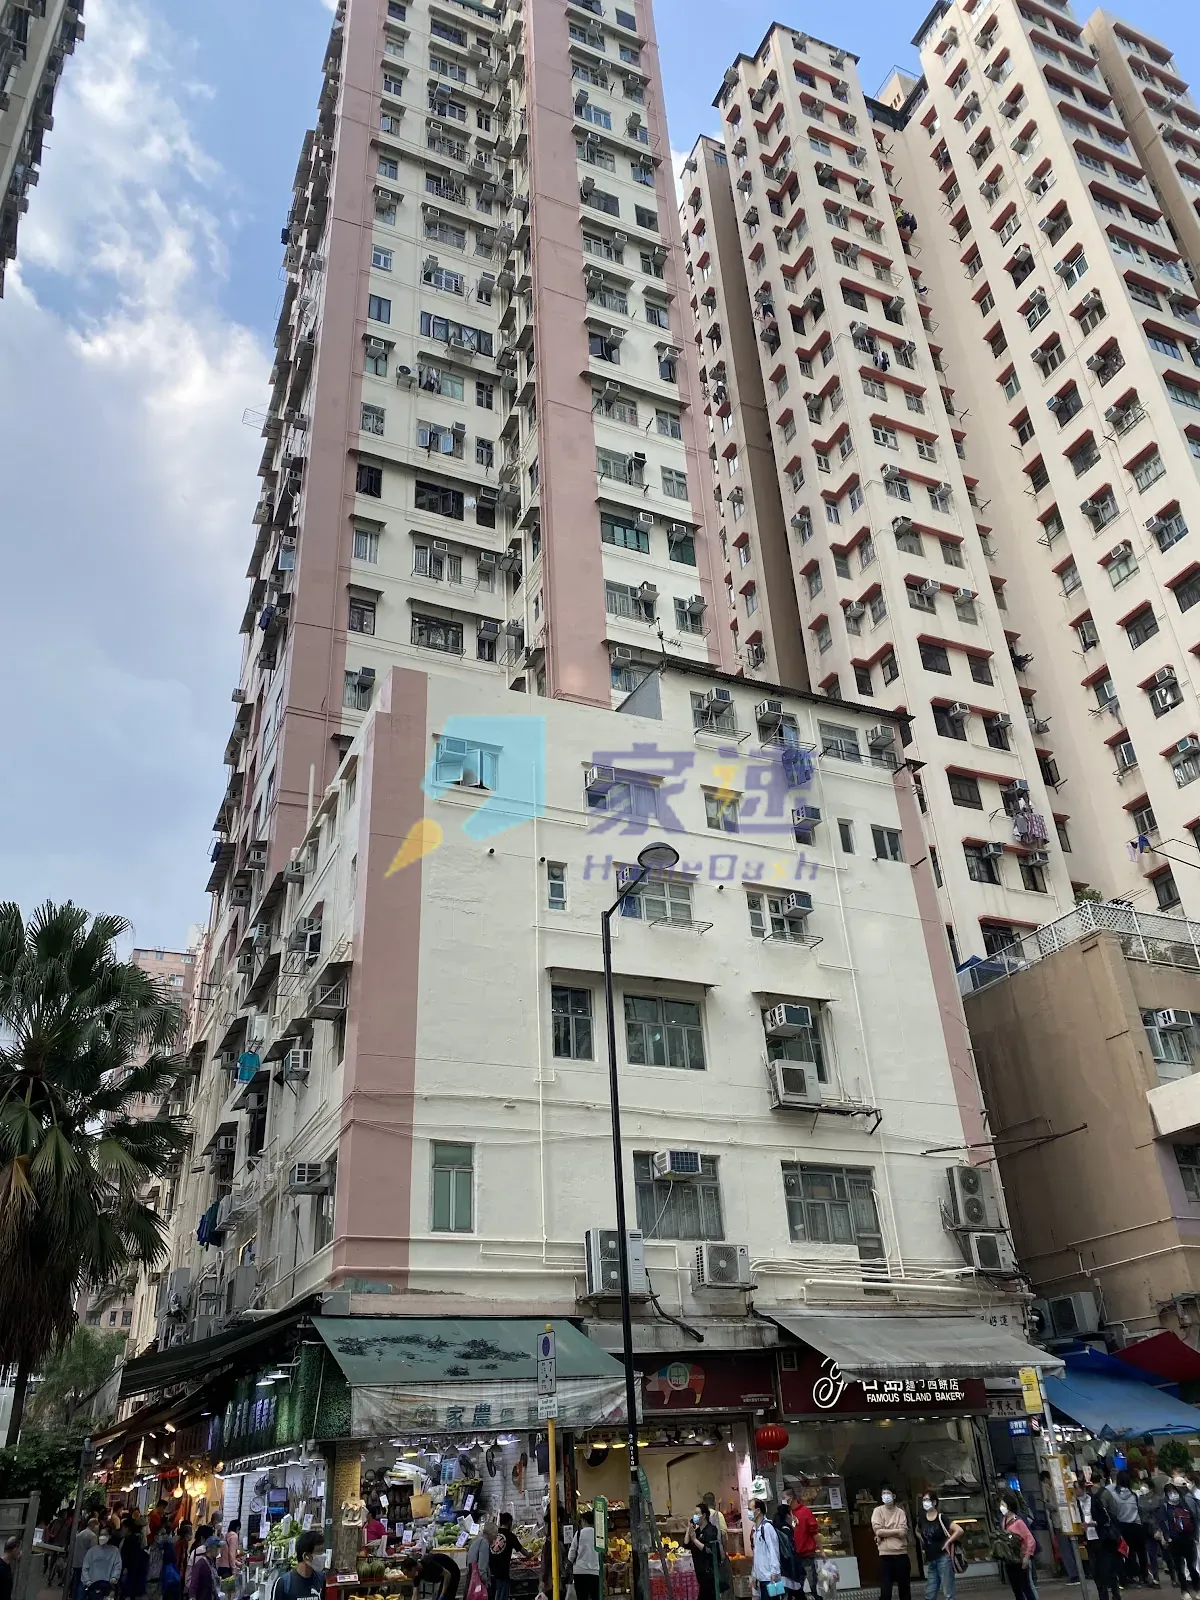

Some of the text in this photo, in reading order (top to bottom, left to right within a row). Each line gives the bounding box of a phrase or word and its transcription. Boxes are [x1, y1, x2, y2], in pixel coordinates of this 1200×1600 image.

[866, 1391, 965, 1402] FAMOUS ISLAND BAKERY
